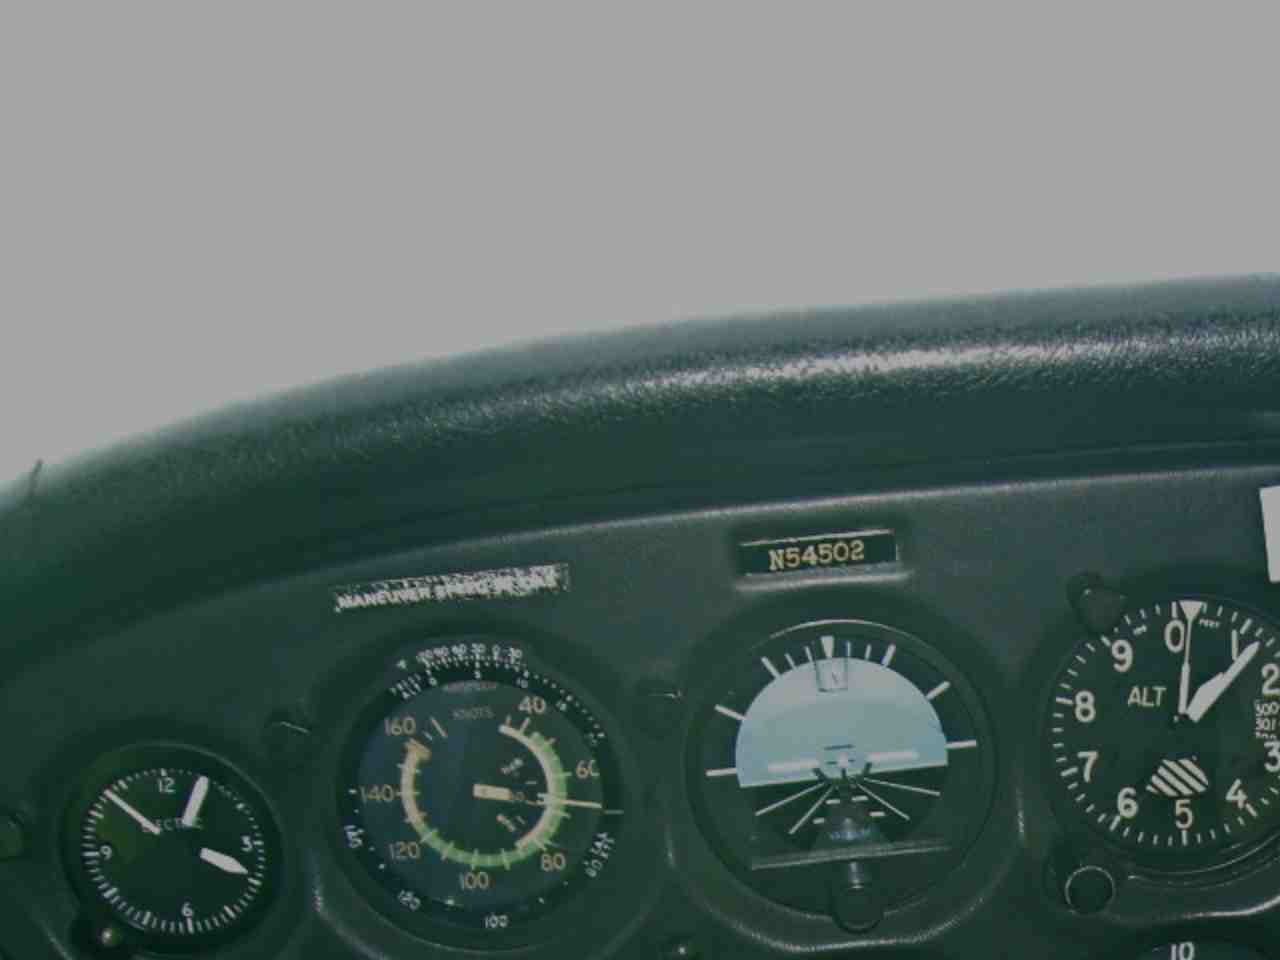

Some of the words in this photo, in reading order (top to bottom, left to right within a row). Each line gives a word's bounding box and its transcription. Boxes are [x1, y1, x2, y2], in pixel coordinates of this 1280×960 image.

[768, 539, 866, 573] N54502
[1164, 619, 1185, 653] 0
[1111, 639, 1133, 672] 9
[1261, 663, 1280, 696] 2
[517, 697, 547, 716] 40
[1074, 690, 1096, 722] 8
[1127, 686, 1166, 708] ALT
[452, 705, 494, 719] KNOTS
[384, 716, 417, 736] 160
[1077, 751, 1098, 783] 7
[156, 778, 176, 794] 12
[360, 785, 395, 804] 140
[1225, 778, 1248, 808] 4
[1117, 787, 1138, 818] 6
[1174, 799, 1193, 829] 5
[101, 845, 113, 861] 9
[388, 841, 422, 860] 120
[540, 852, 567, 872] 80
[460, 872, 489, 890] 100
[181, 901, 194, 918] 6
